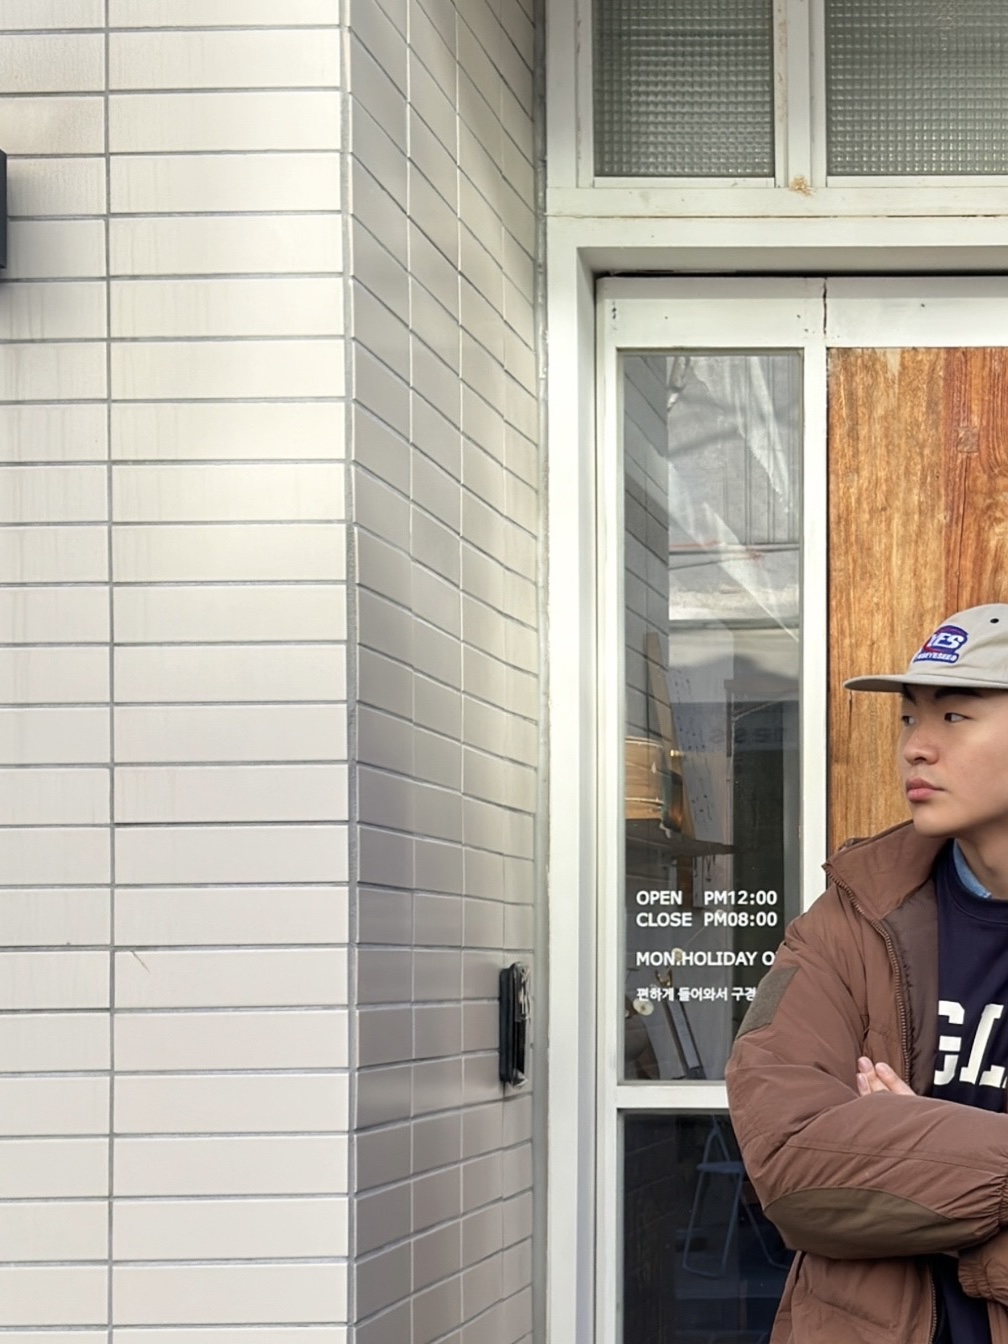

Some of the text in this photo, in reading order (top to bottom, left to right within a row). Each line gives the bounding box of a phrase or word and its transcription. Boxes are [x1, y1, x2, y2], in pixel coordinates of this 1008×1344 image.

[636, 890, 777, 905] OPEN PM12:00
[636, 912, 777, 927] CLOSE PM08:00
[636, 986, 757, 1001] 편하게 들어와서 구경
